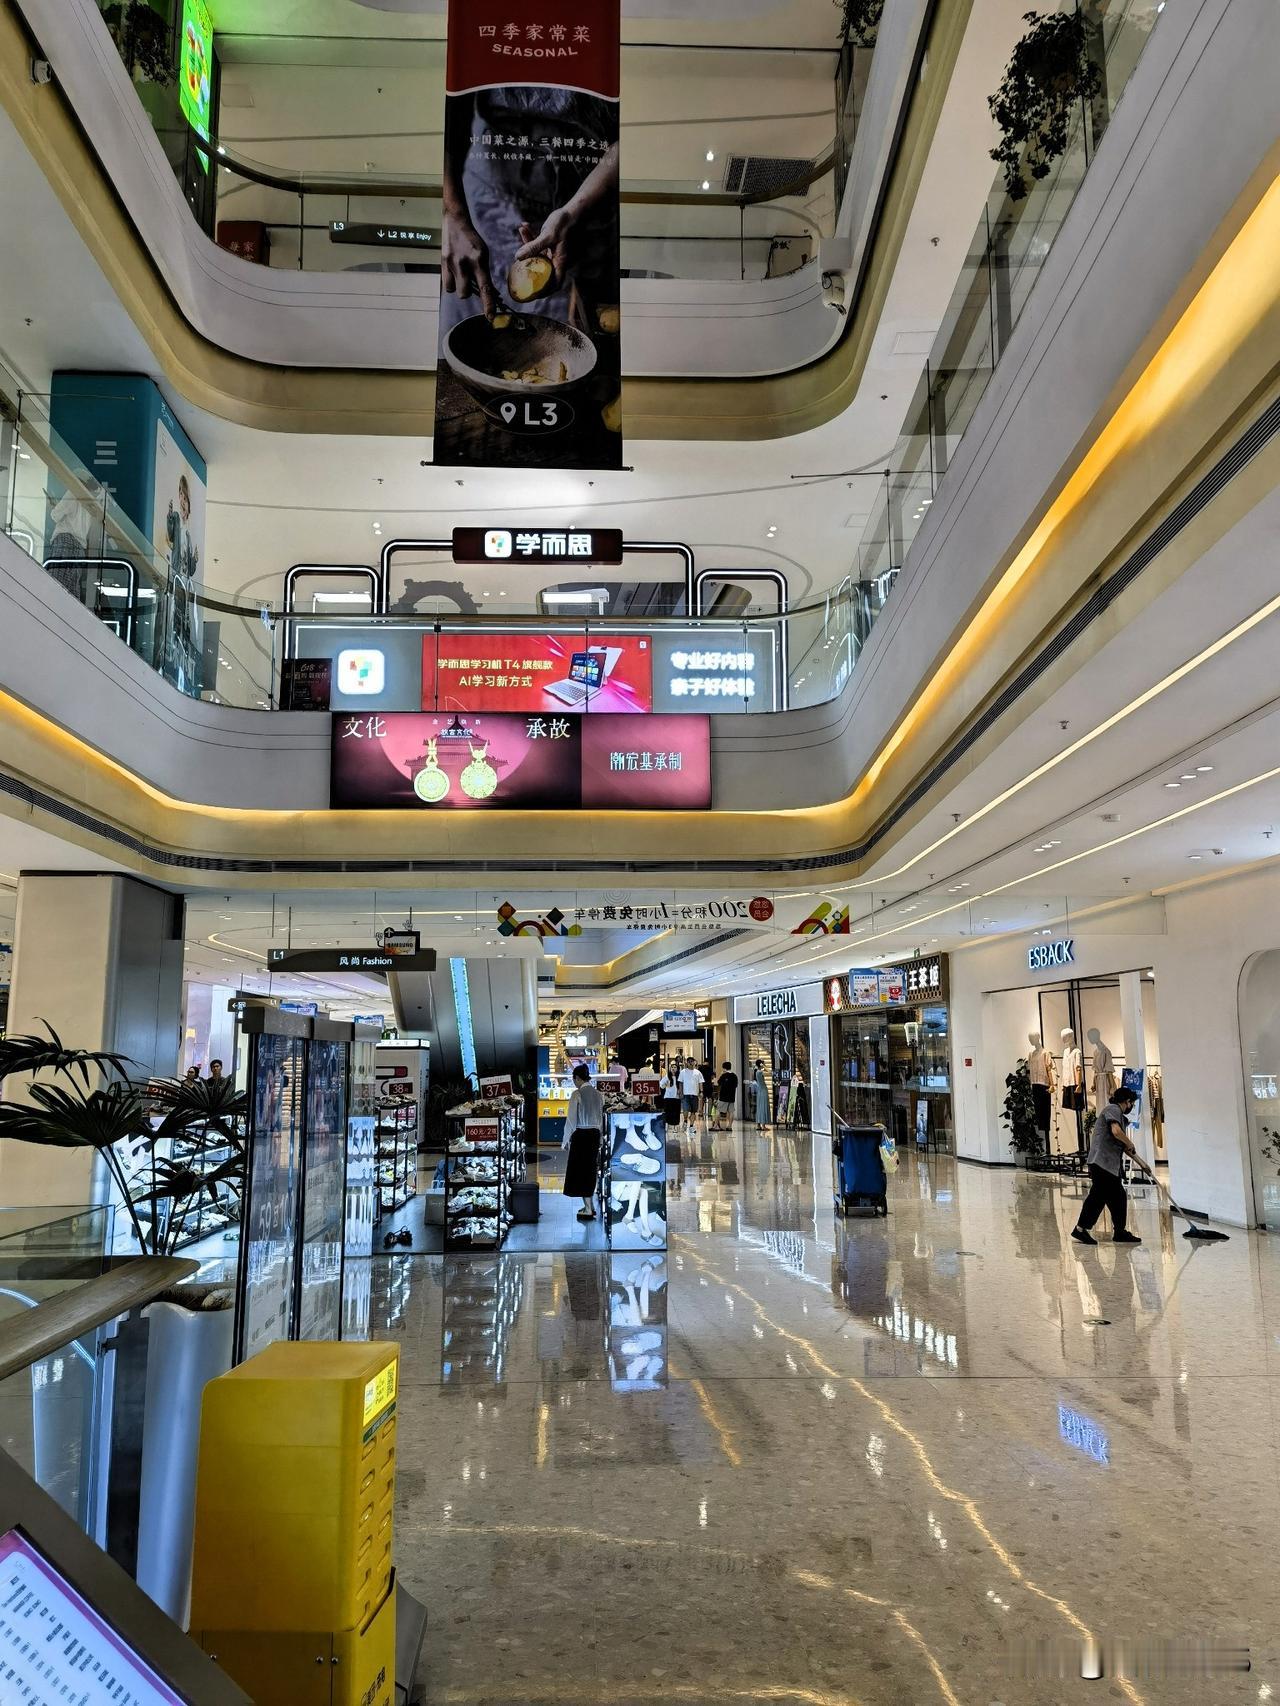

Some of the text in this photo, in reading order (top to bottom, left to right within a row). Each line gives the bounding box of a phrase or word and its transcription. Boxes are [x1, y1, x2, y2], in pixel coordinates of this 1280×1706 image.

[478, 22, 591, 43] 四季家常菜
[491, 43, 578, 58] SEASONAL
[333, 222, 345, 231] L3
[387, 230, 398, 239] L2
[416, 233, 432, 241] Enjoy
[524, 402, 558, 426] L3
[516, 533, 592, 556] 学而思
[437, 658, 554, 670] 学而思学习机 T4 旗舰款
[458, 675, 533, 688] AI学习新方式
[341, 716, 571, 739] 文化 承故
[273, 951, 285, 960] L1
[339, 956, 393, 966] 风尚 Fashion
[1028, 940, 1073, 969] ESBACK
[904, 965, 939, 991] 王茶姬
[757, 991, 797, 1016] LELECHA
